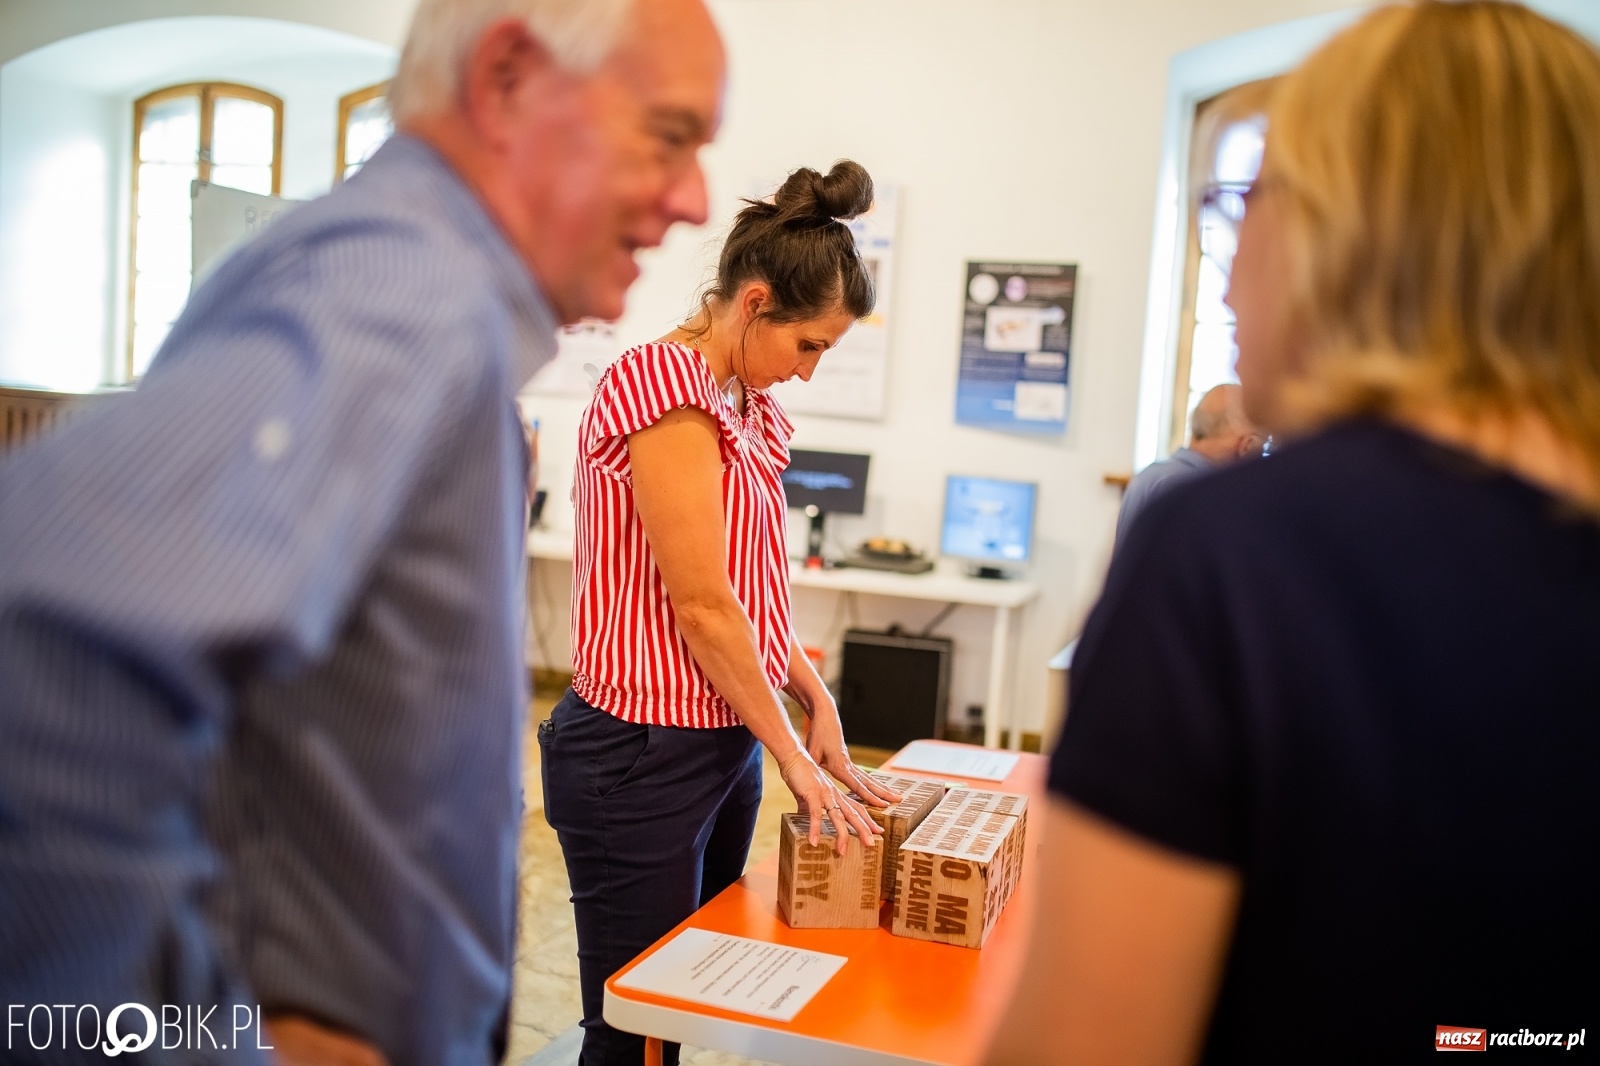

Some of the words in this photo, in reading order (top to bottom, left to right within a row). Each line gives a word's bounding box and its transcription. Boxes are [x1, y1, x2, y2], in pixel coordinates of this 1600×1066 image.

[794, 840, 840, 910] ÓRY.
[940, 855, 972, 881] O
[934, 893, 969, 935] MA
